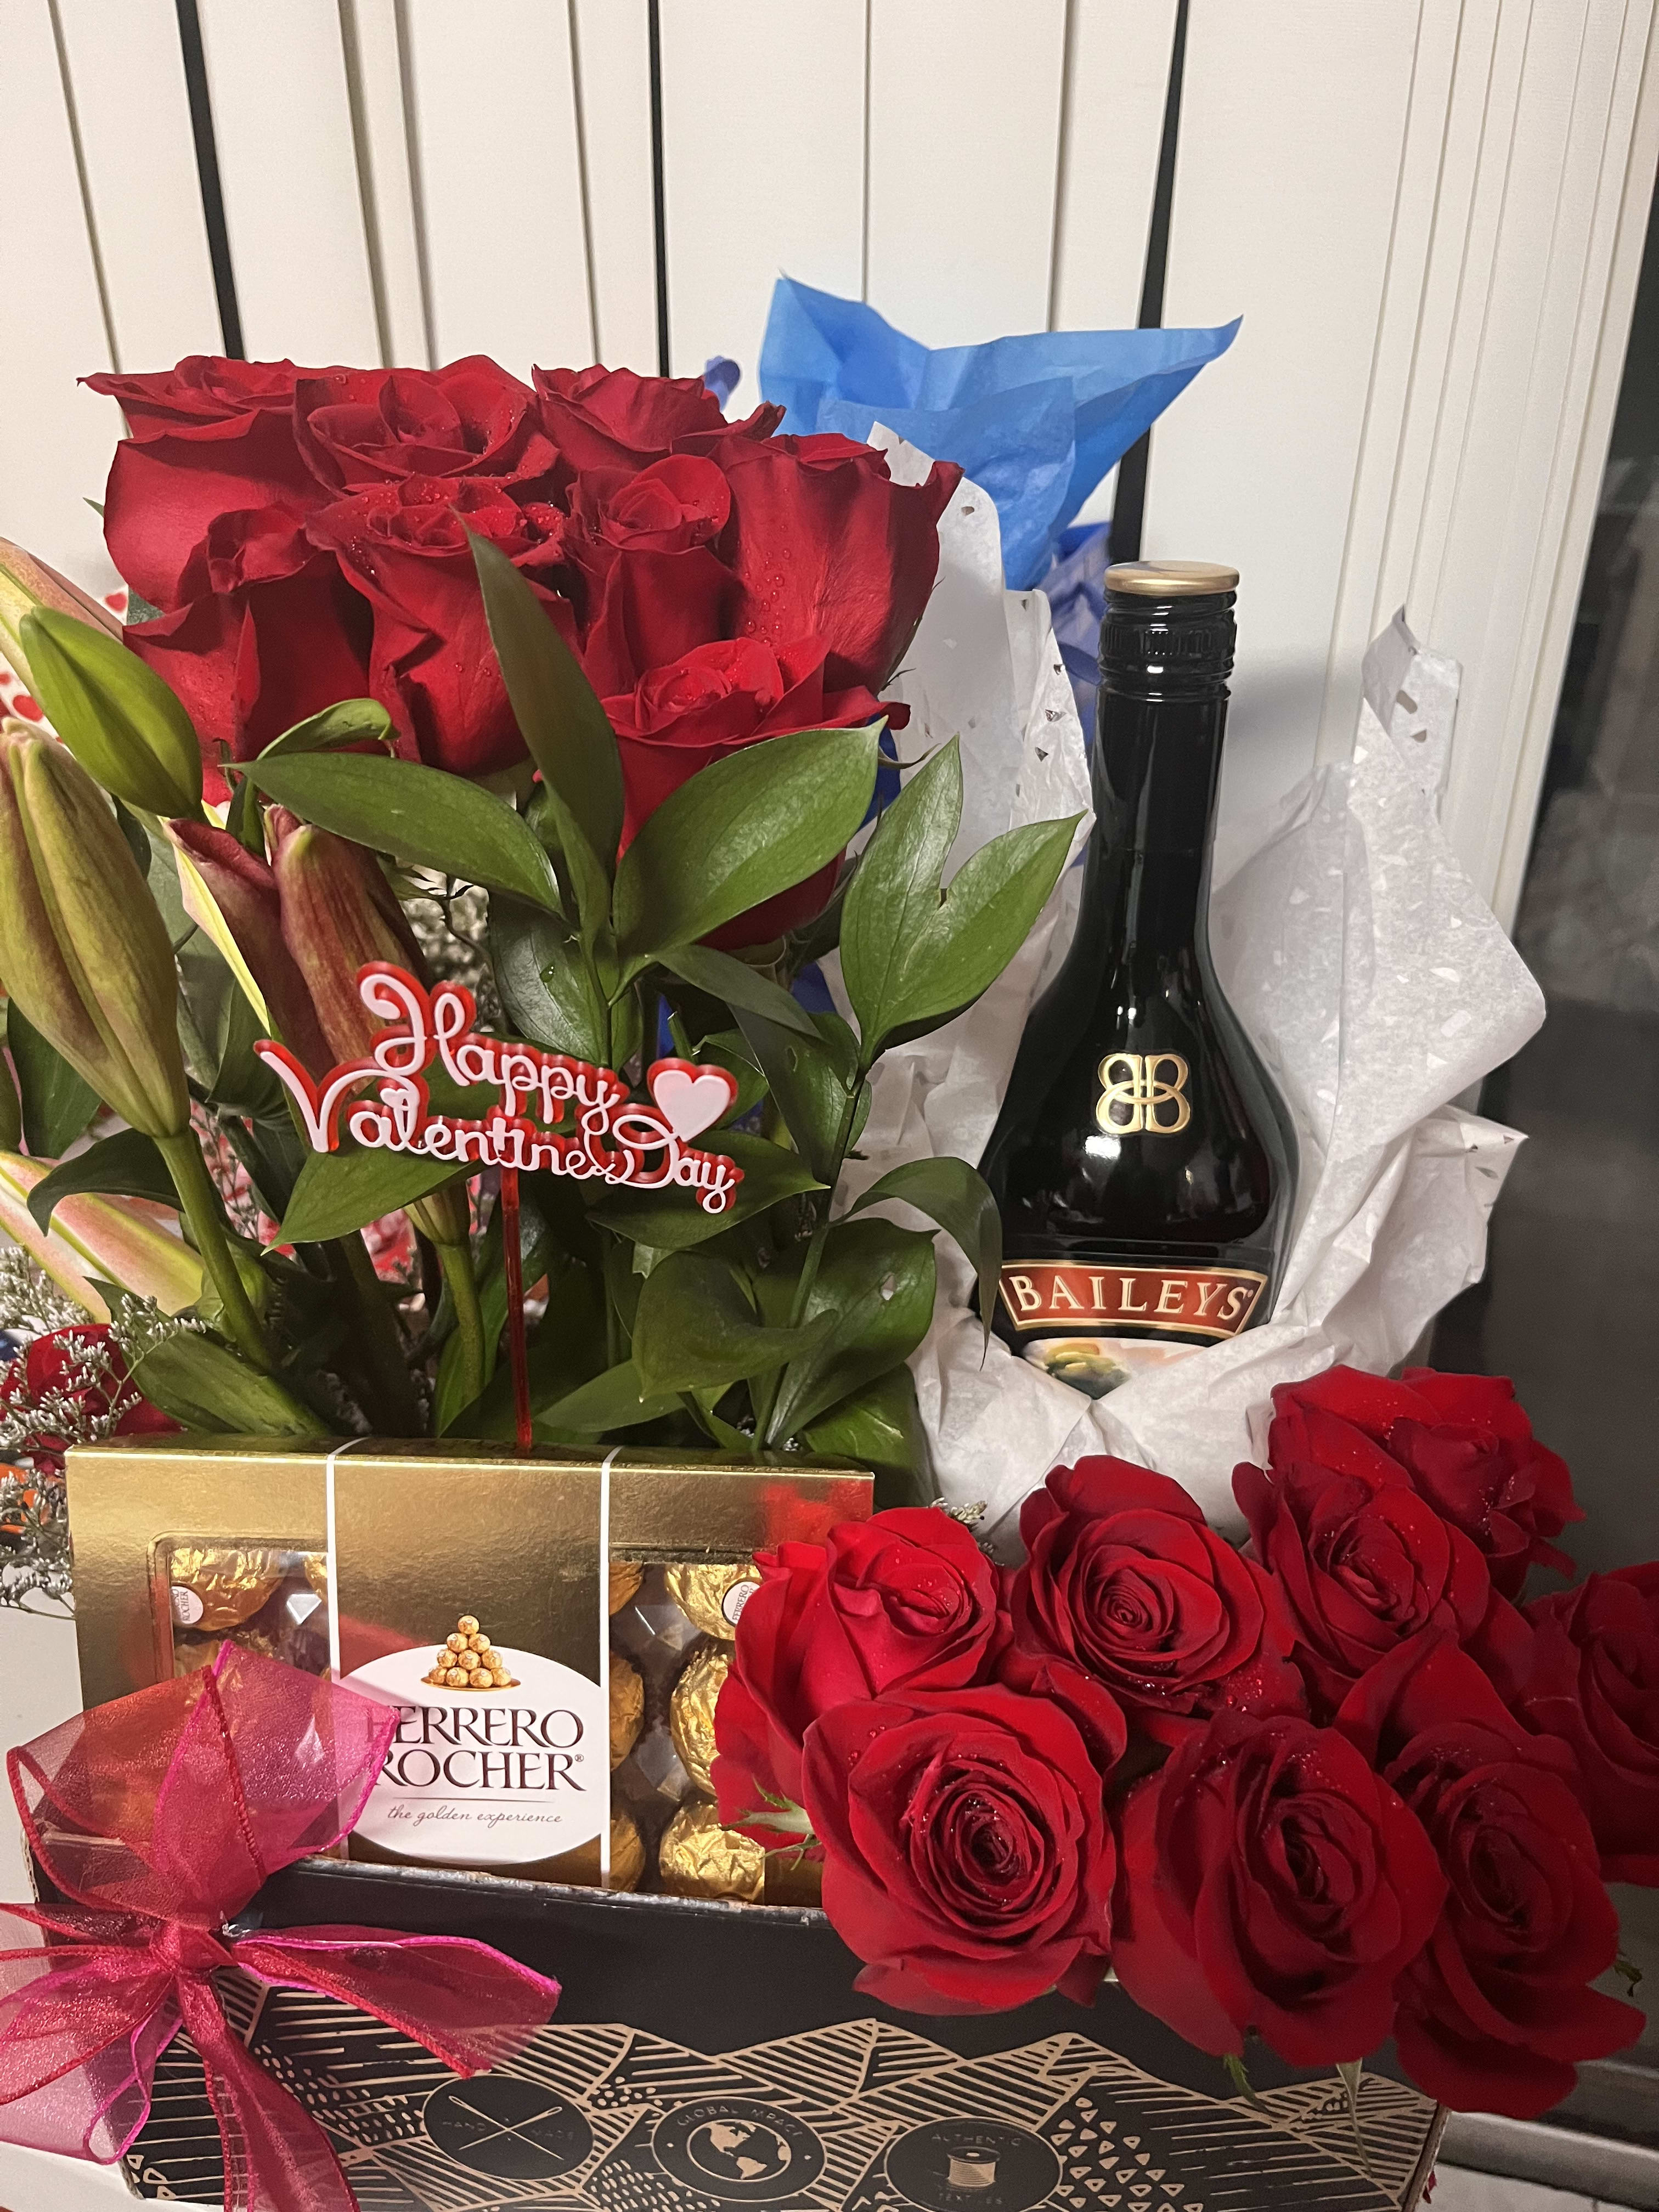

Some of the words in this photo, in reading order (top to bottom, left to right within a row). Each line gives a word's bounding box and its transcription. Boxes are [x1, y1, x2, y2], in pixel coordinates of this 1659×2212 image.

[359, 973, 620, 1136] Happy
[605, 1114, 735, 1214] Day
[1008, 1275, 1250, 1322] BAILEYS
[387, 1804, 412, 1819] the
[413, 1805, 472, 1827] golden
[477, 1811, 563, 1829] experience
[677, 2106, 739, 2126] GLOBAL
[749, 2108, 803, 2136] MPACT
[932, 2133, 1021, 2147] AUTHENTC
